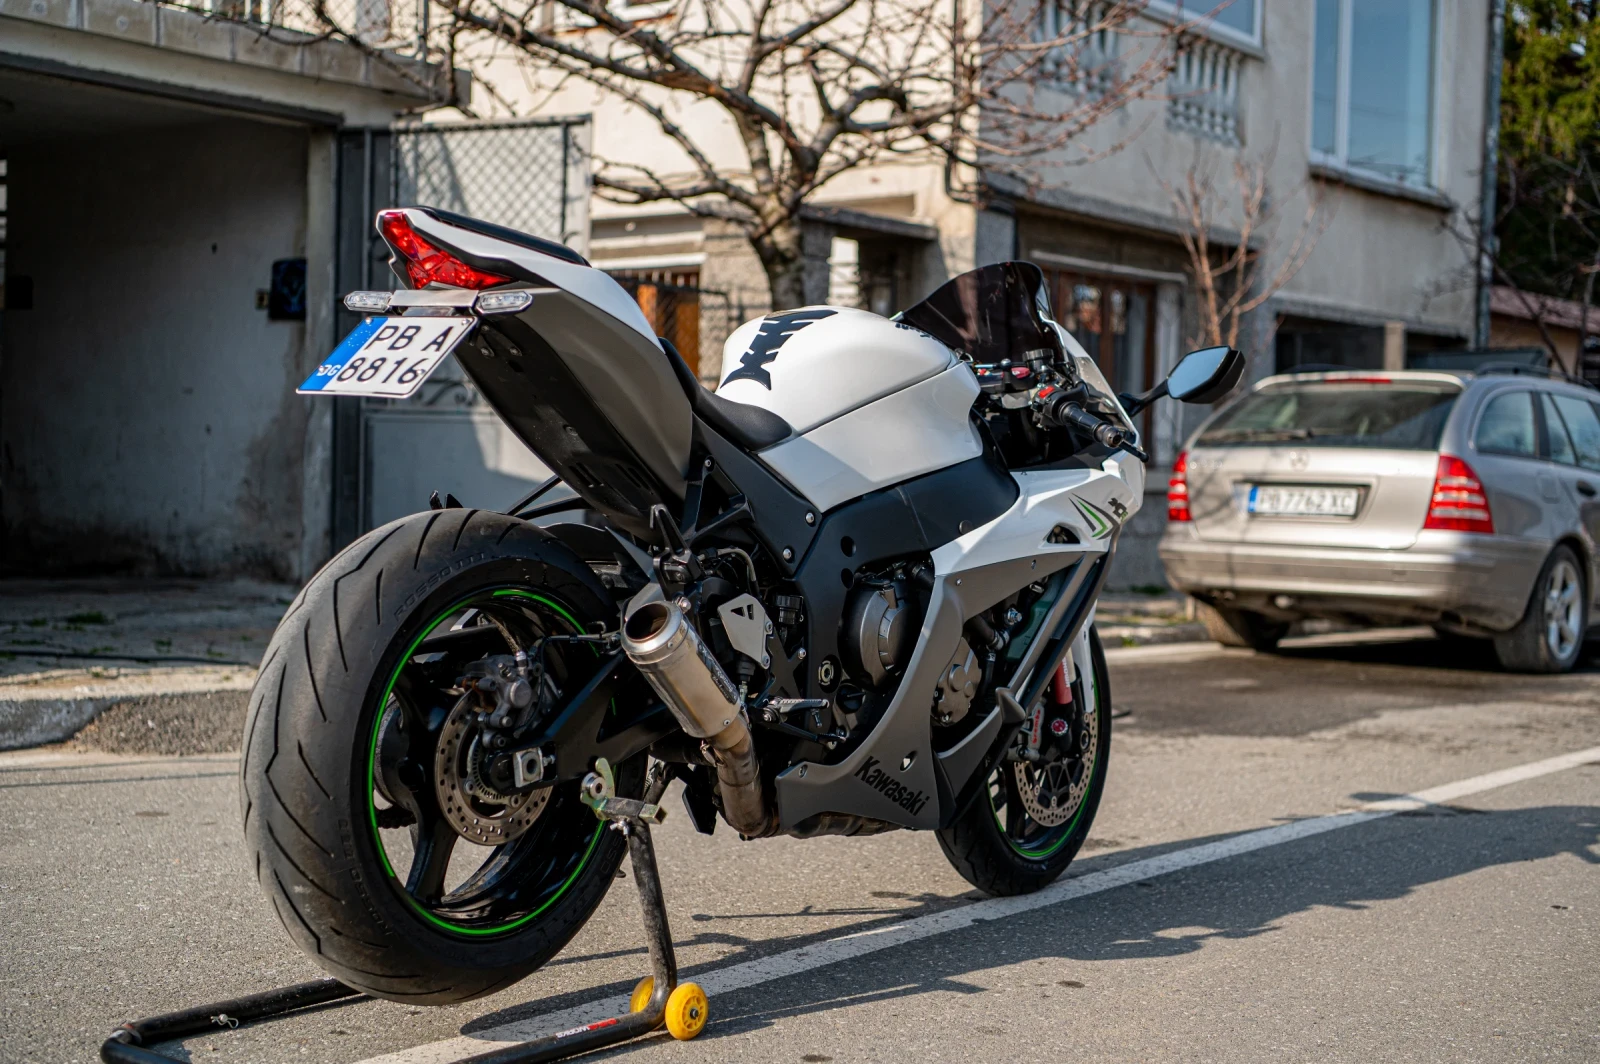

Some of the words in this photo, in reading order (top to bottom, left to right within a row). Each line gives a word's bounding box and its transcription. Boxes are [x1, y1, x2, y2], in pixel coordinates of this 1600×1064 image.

[364, 325, 422, 351] PB
[421, 325, 455, 352] A
[336, 356, 430, 384] 8816
[394, 565, 453, 622] ROSSO
[1032, 709, 1041, 743] brembo
[854, 755, 931, 817] Kawasaki
